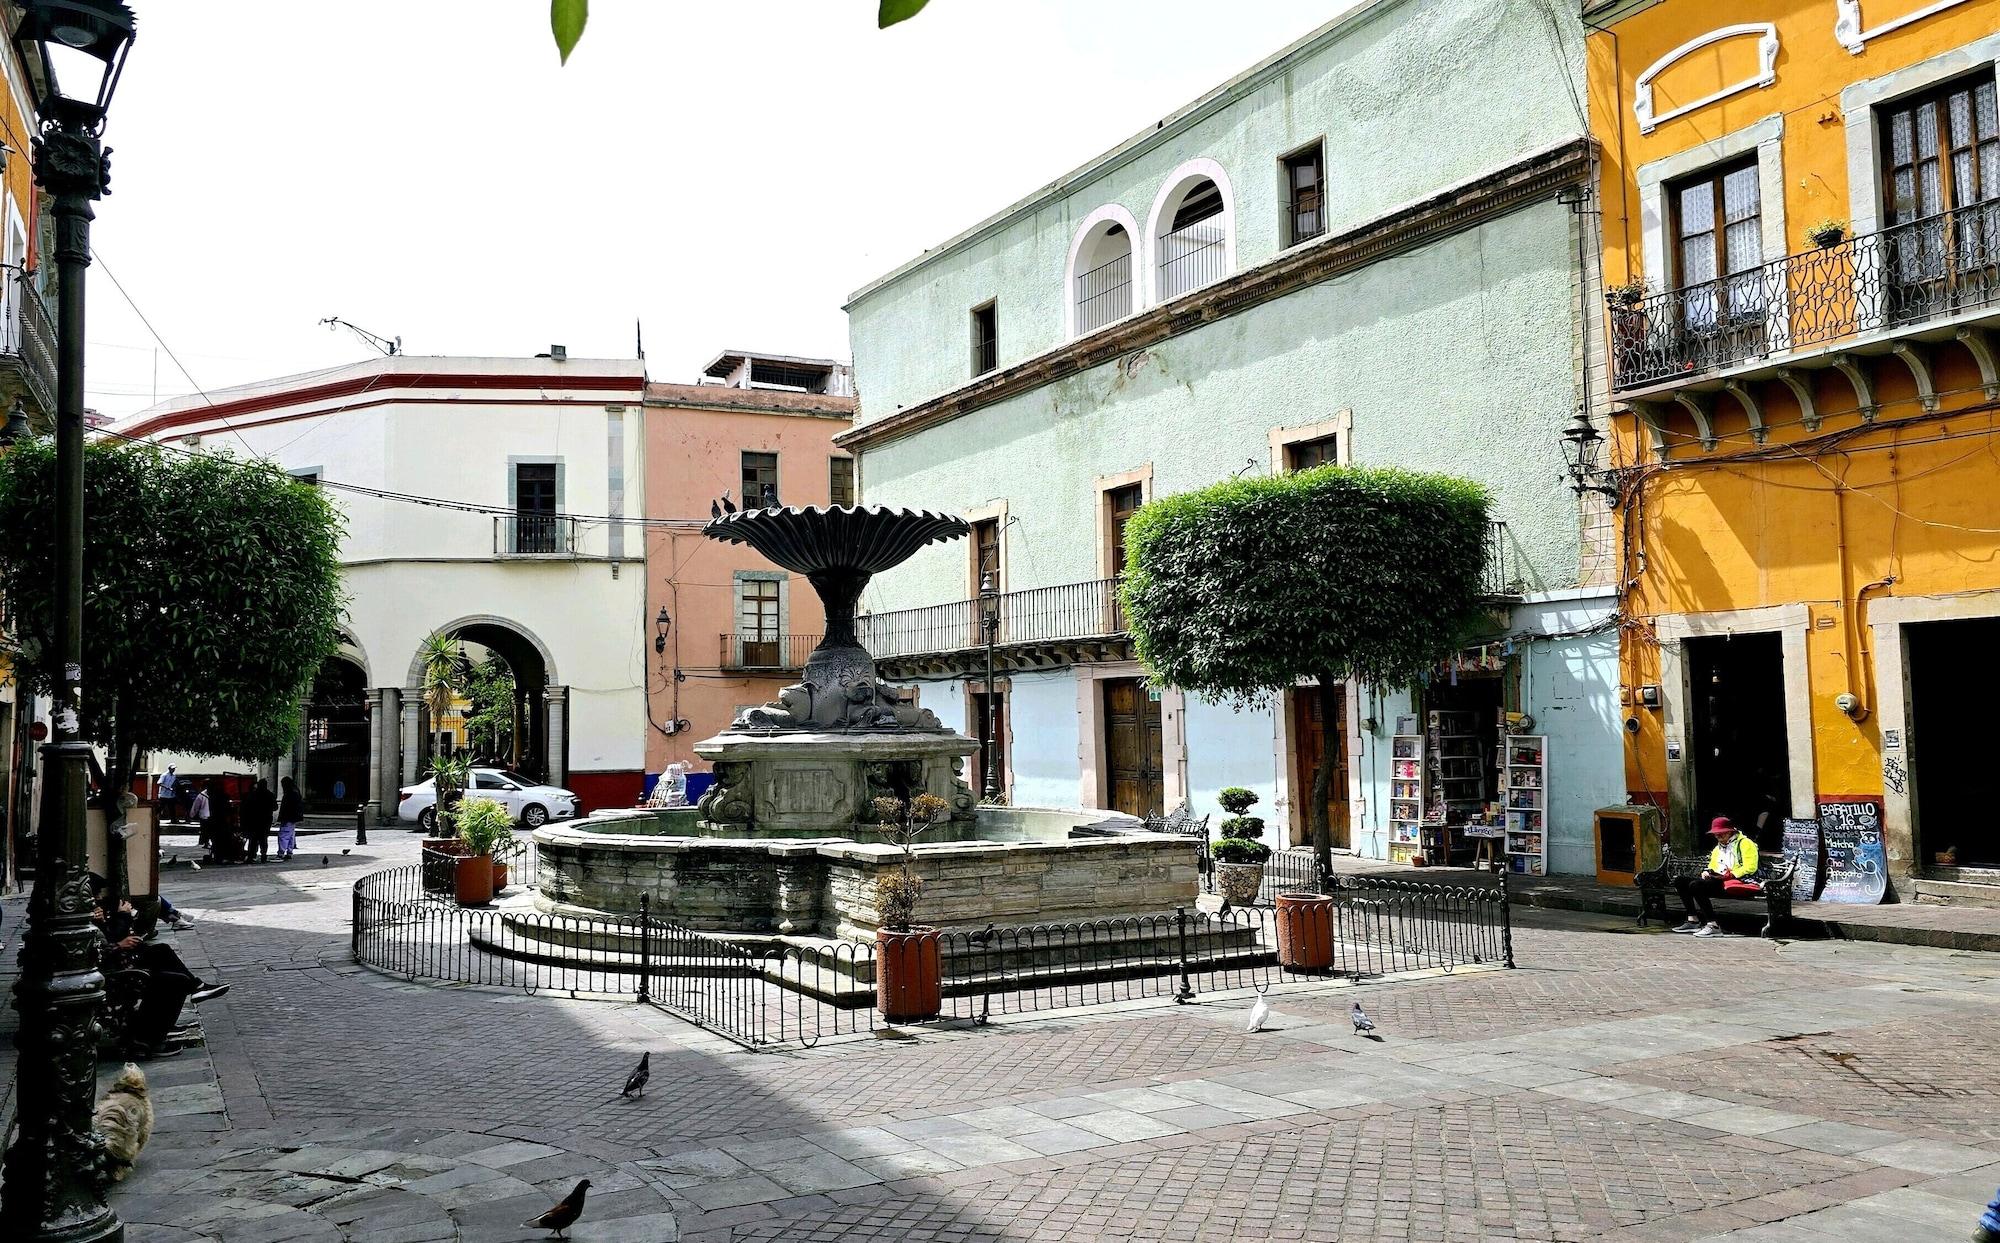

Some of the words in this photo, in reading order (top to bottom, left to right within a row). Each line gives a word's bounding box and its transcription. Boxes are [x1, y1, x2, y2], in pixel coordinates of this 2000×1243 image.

[1820, 803, 1875, 816] BARATILLO
[1840, 814, 1856, 826] 16
[1825, 838, 1854, 848] Matcha
[1825, 848, 1846, 857] Taro
[1826, 857, 1845, 868] Chai
